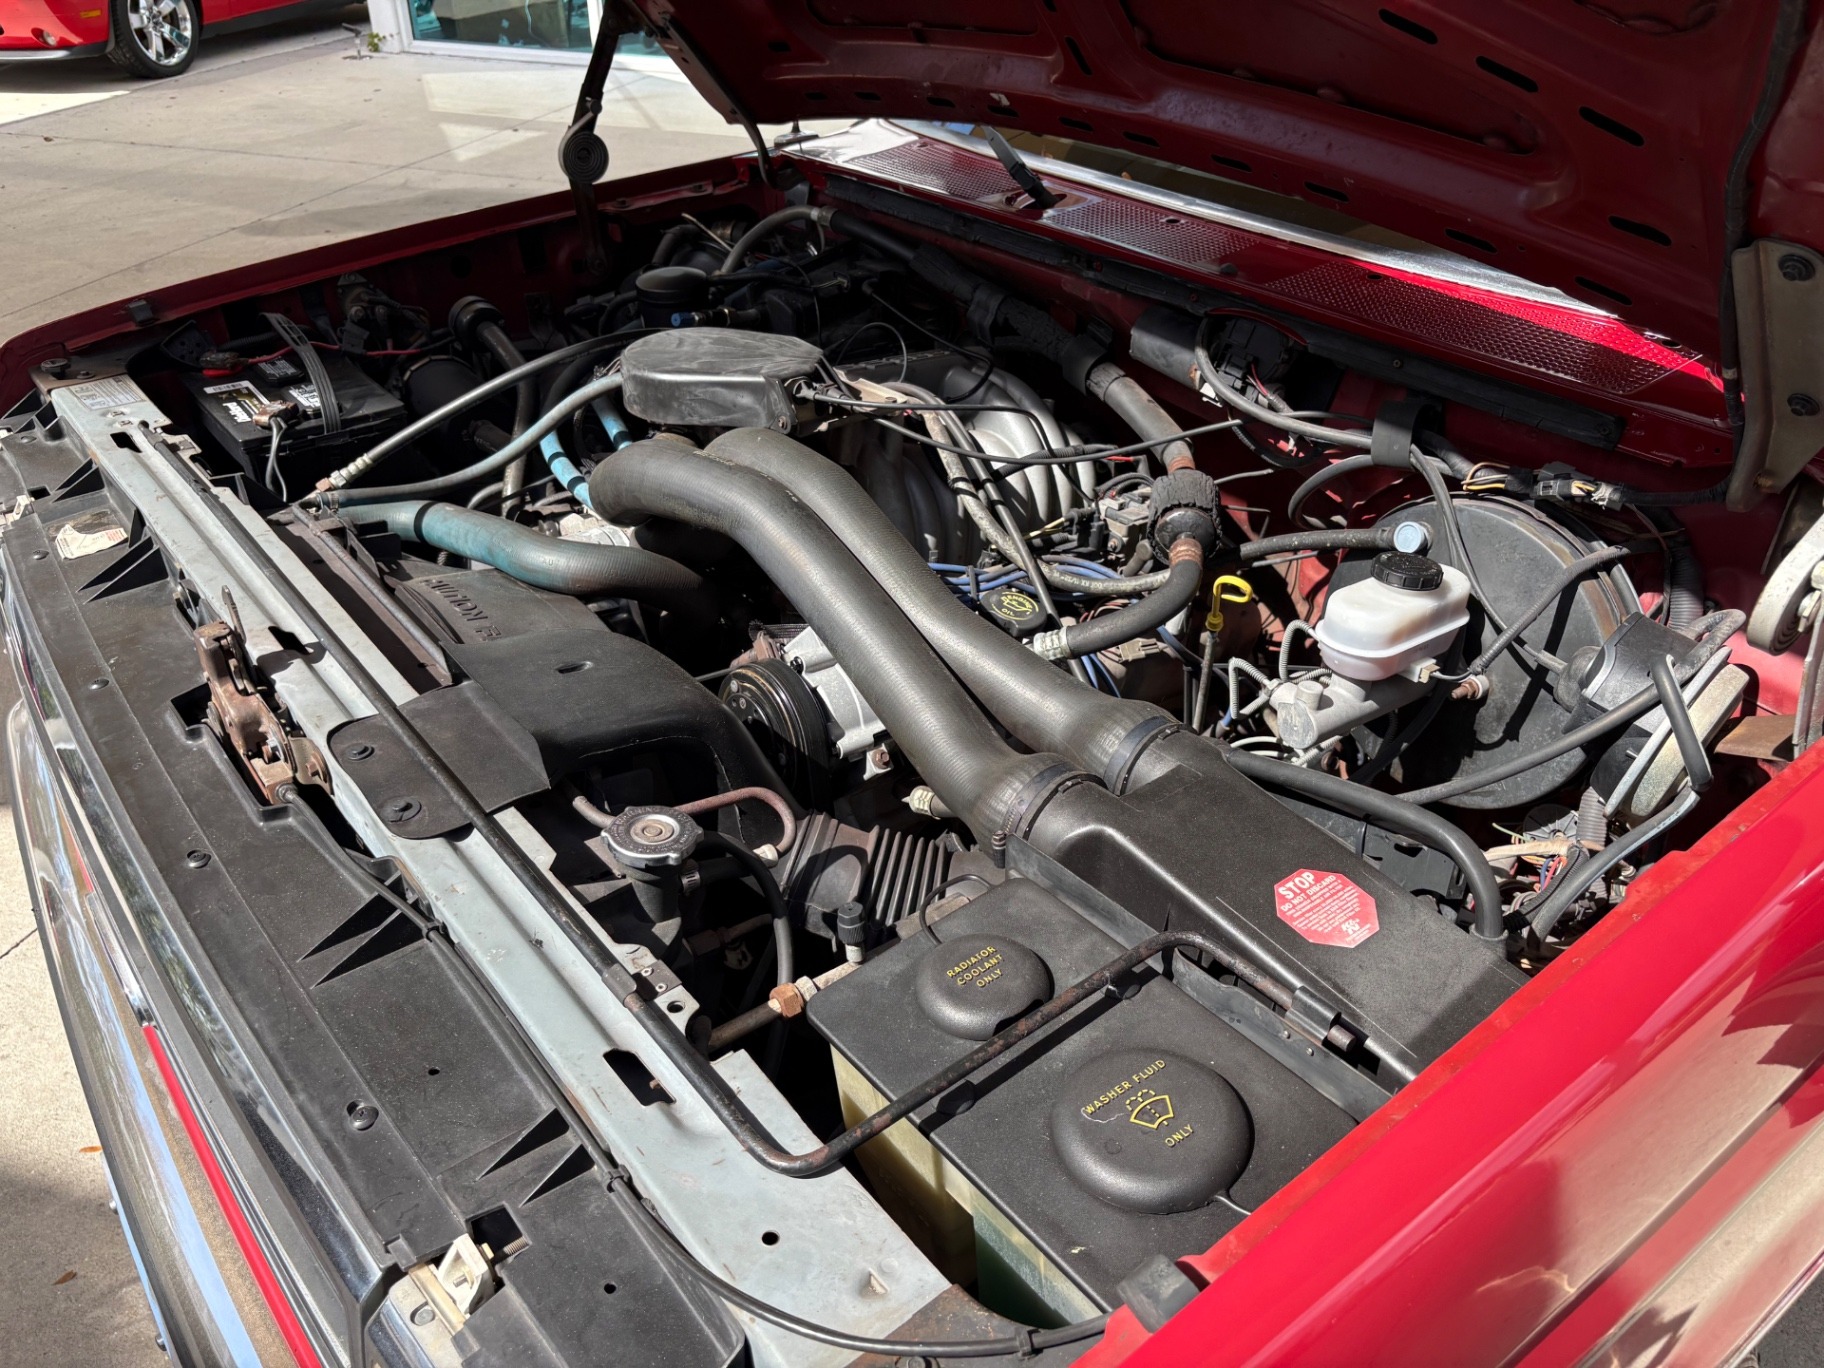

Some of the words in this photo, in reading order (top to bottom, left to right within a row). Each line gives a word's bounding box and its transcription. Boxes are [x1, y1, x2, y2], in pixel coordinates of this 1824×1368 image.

[1001, 608, 1015, 616] OIL
[1278, 871, 1315, 899] STOP
[1281, 903, 1292, 911] DO
[1292, 894, 1307, 904] NOT
[1308, 875, 1336, 895] DISCARD
[946, 945, 997, 977] RADIATOR
[956, 953, 1003, 986] COOLANT
[975, 968, 1003, 988] ONLY
[1084, 1081, 1133, 1115] WASHER
[1132, 1059, 1167, 1083] FLUID
[1164, 1123, 1194, 1148] ONLY
